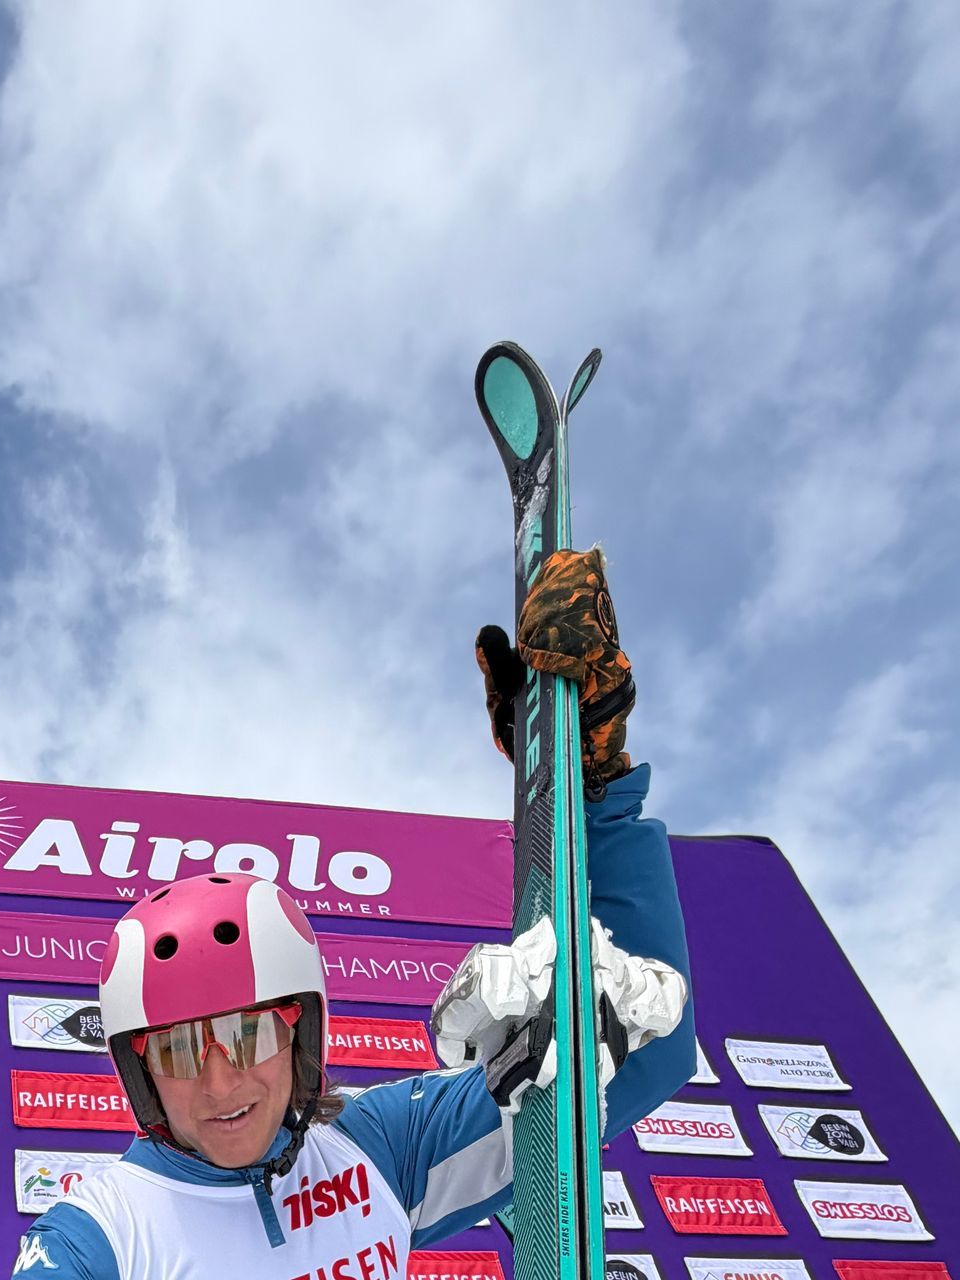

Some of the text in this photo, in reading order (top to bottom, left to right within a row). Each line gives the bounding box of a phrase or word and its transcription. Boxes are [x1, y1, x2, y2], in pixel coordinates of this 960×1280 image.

[3, 819, 392, 896] Airolo
[298, 899, 392, 916] UMMER
[1, 935, 108, 962] JUNIO
[321, 955, 455, 984] HAMPIO
[79, 1015, 102, 1024] BELL
[327, 1033, 427, 1052] RAIFFEISEN
[637, 1117, 735, 1140] SWISSLOS
[561, 1204, 569, 1225] RIDE
[603, 1201, 629, 1217] ARI
[666, 1196, 771, 1216] RAIFFEISEN
[812, 1200, 913, 1222] SWISSLOS
[562, 1226, 570, 1257] SKIERS
